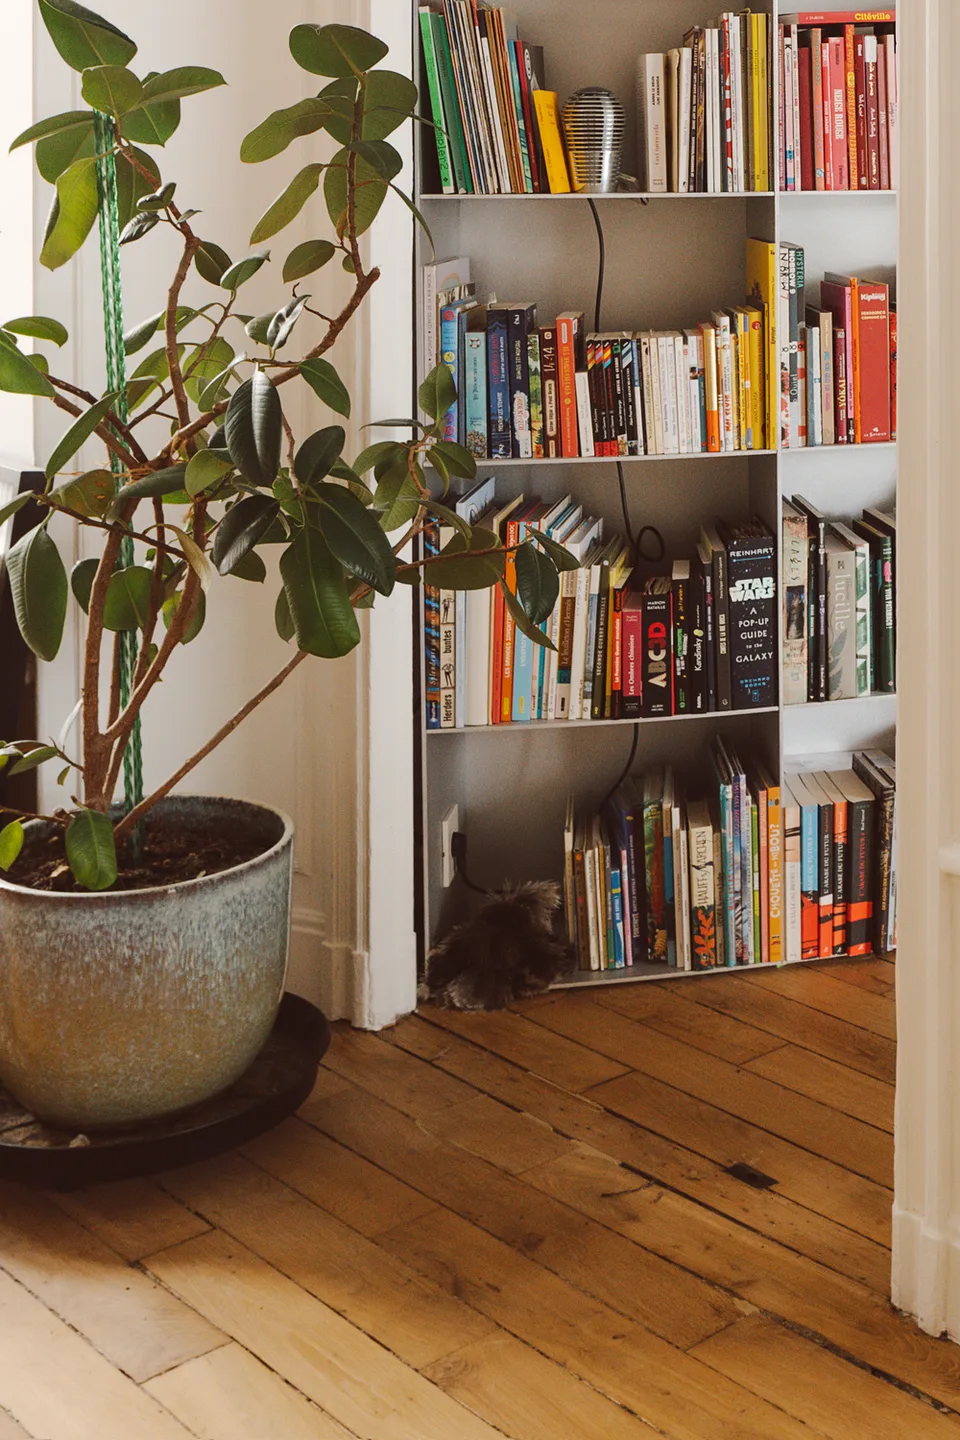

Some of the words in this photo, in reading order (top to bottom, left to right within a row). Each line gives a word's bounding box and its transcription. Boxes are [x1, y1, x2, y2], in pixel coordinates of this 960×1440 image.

[834, 89, 844, 112] NEIGE
[835, 114, 844, 139] ROUGE
[796, 251, 804, 288] HYSTERIA
[860, 293, 886, 302] Kipling
[790, 373, 798, 396] Quiet
[730, 548, 774, 558] REINHART
[729, 587, 775, 602] WARS
[734, 577, 775, 591] STAR
[885, 588, 893, 600] VIVA
[562, 599, 573, 627] d'Hermès
[834, 574, 851, 631] lucille
[885, 600, 893, 626] PATAMACH
[738, 618, 769, 628] POP-UP
[442, 630, 454, 654] buntes
[561, 628, 572, 657] feuilleton
[598, 628, 606, 649] GUERRE
[740, 630, 768, 640] GUIDE
[504, 643, 512, 666] GRANDES
[628, 635, 636, 661] chinoises
[647, 622, 667, 688] ABC3D
[695, 638, 703, 671] Kandinsky
[736, 652, 774, 663] GALAXY
[428, 648, 438, 686] Splendeurs
[628, 662, 636, 685] Ombres
[628, 686, 636, 696] Les
[442, 694, 454, 722] Herders
[770, 824, 781, 860] HIBOU?
[806, 866, 813, 875] DU
[824, 857, 830, 866] DU
[837, 863, 844, 872] DU
[860, 864, 866, 873] DU
[768, 867, 781, 918] CHOUETTE
[631, 913, 640, 938] FORTNITE
